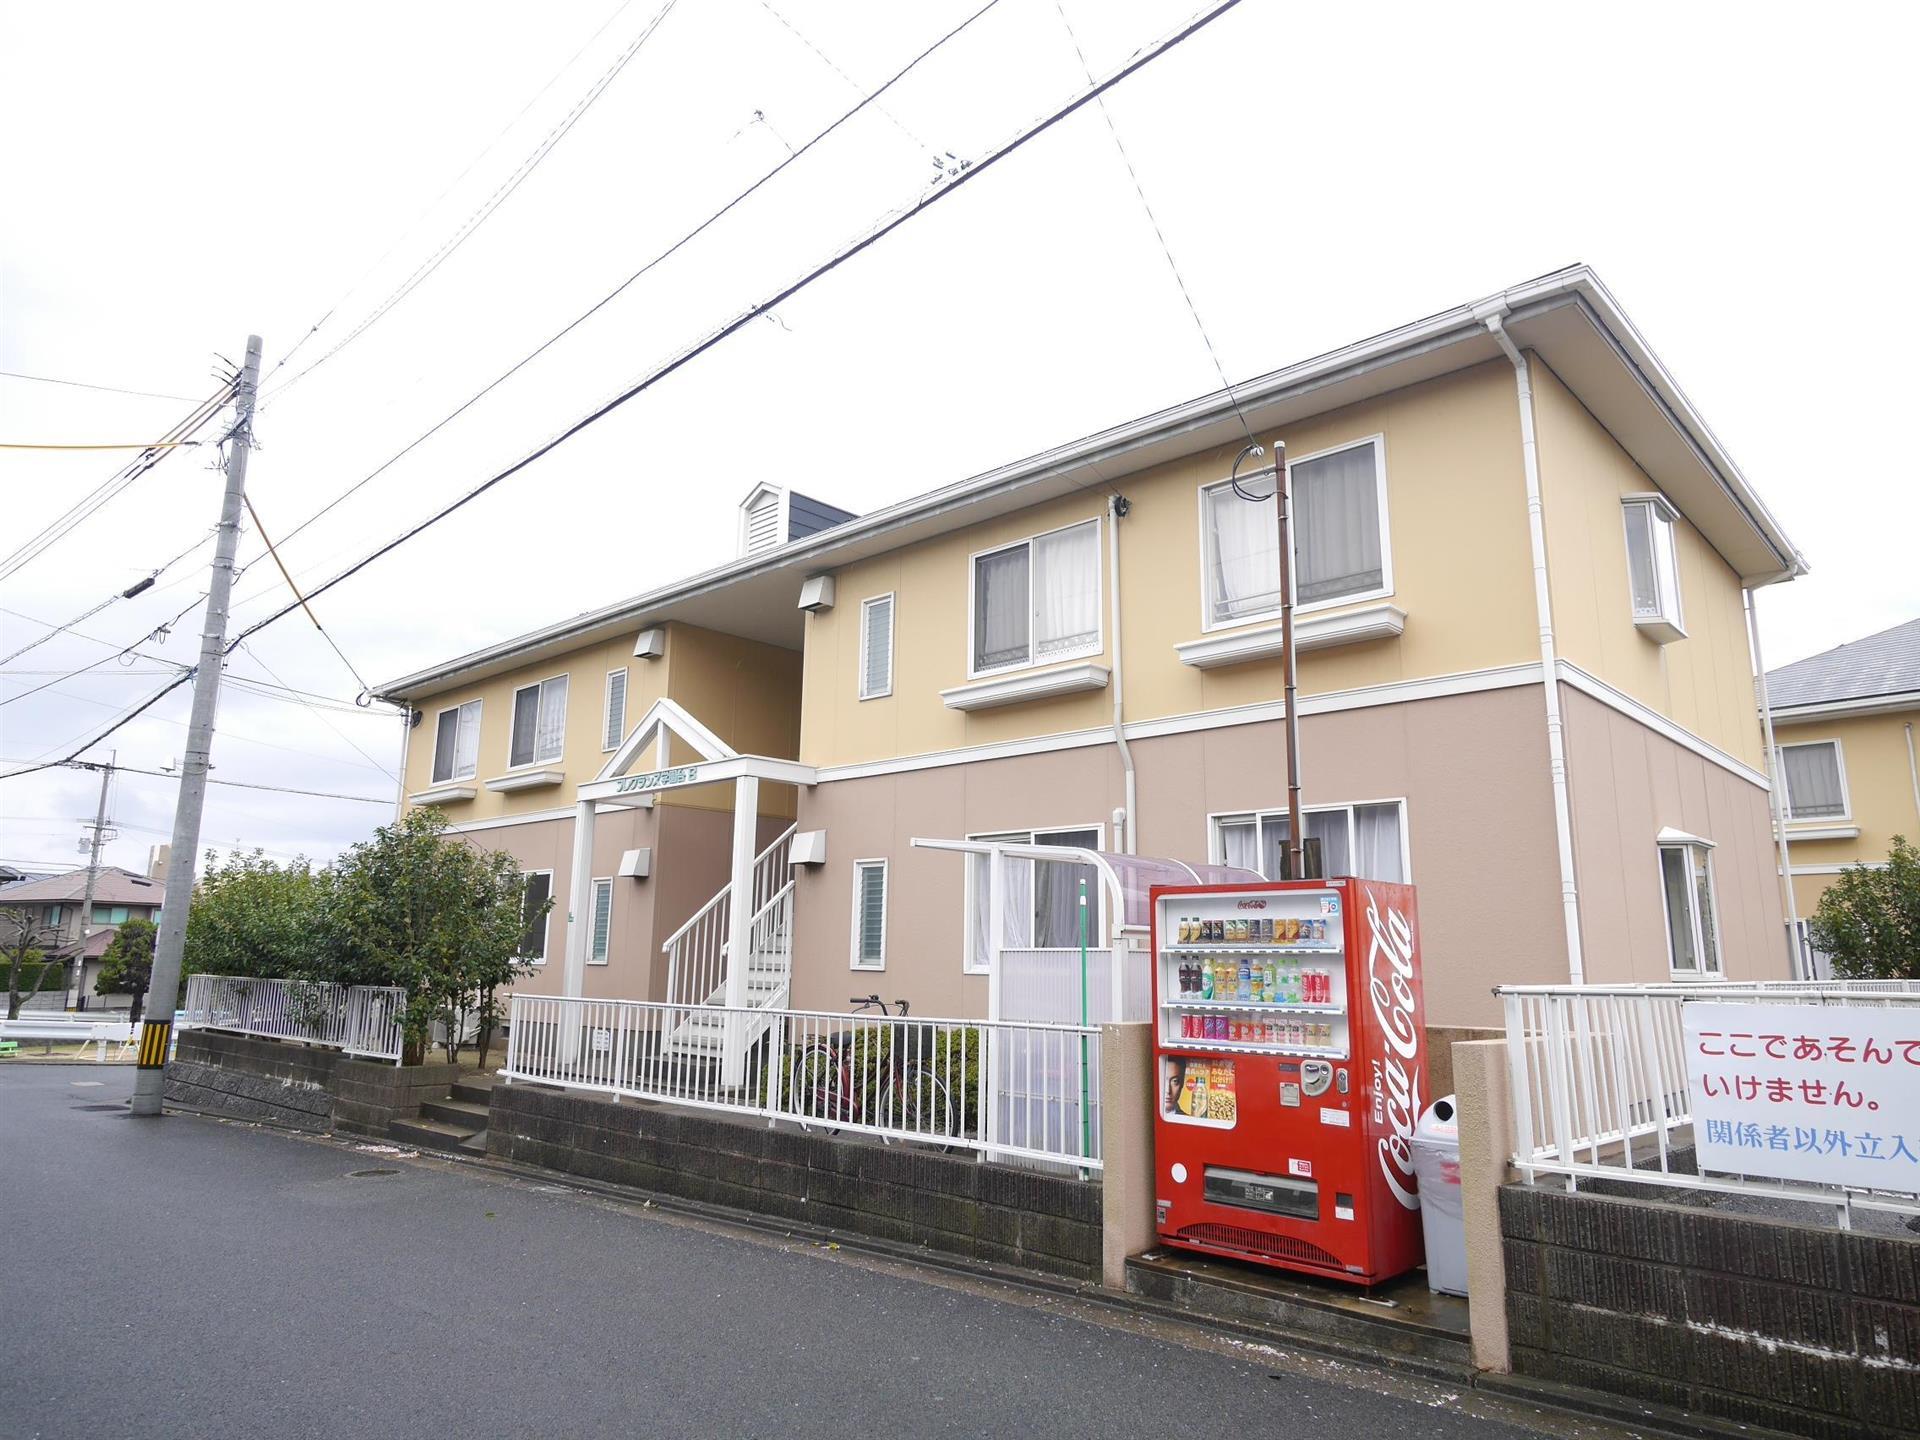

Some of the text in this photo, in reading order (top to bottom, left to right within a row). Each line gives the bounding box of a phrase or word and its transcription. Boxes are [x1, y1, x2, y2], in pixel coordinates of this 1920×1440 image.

[1371, 1059, 1384, 1125] Enjoy!
[1703, 1073, 1880, 1111] いけません。
[1706, 1118, 1920, 1164] 関係者以外立入
